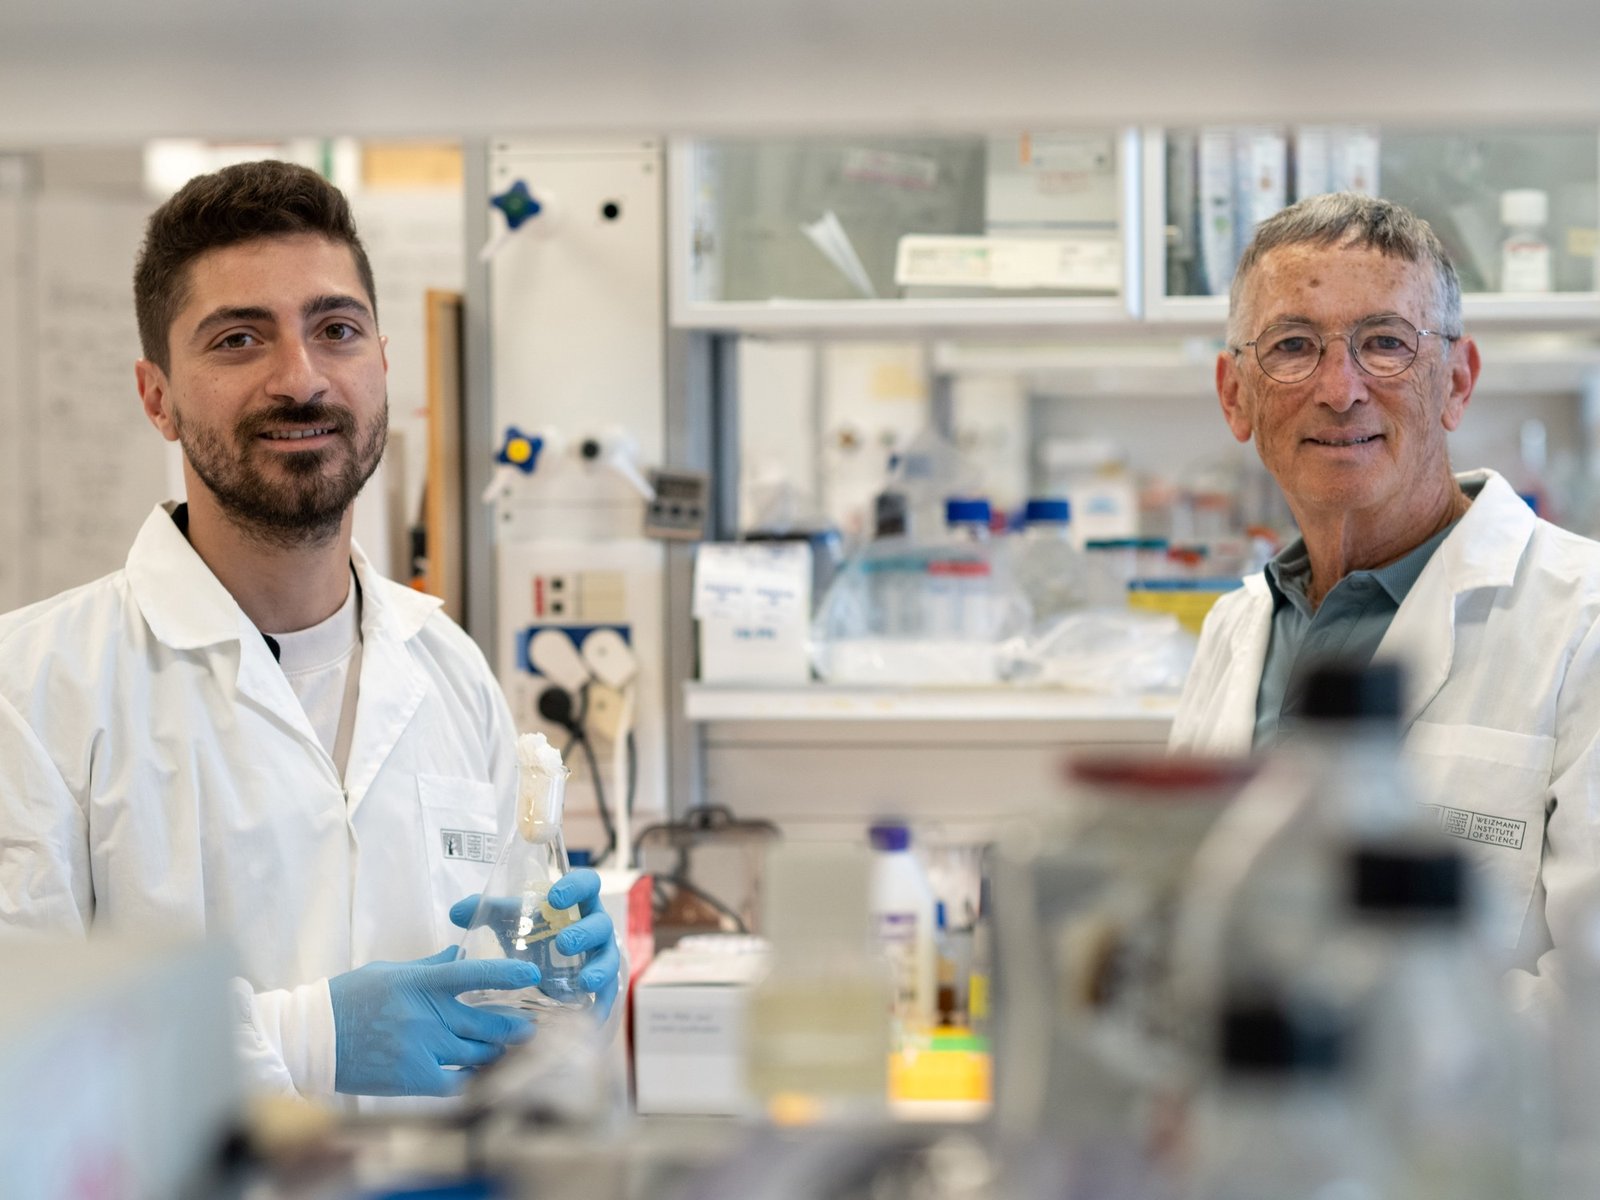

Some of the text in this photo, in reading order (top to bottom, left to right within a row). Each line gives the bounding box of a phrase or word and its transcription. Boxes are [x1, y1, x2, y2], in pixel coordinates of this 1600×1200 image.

[1475, 816, 1520, 830] WEIZMANN
[1474, 824, 1514, 837] INSTITUTE
[1472, 831, 1519, 846] OF SCIENCE
